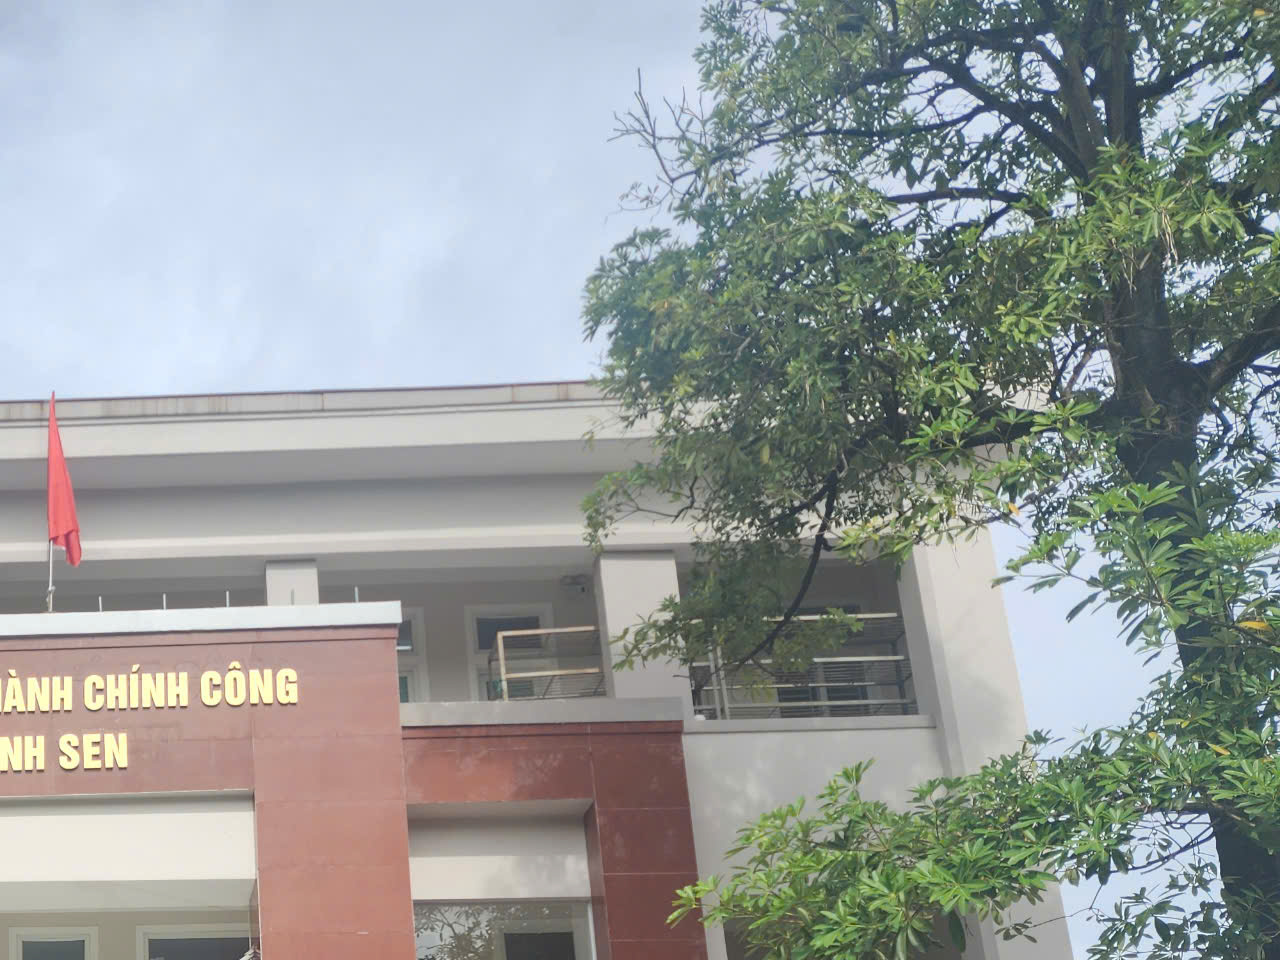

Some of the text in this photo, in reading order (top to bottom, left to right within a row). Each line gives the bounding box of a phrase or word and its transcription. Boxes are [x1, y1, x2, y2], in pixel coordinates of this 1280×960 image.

[84, 664, 189, 711] CHÍNH
[200, 661, 298, 707] CÔNG
[58, 733, 128, 771] SEN
